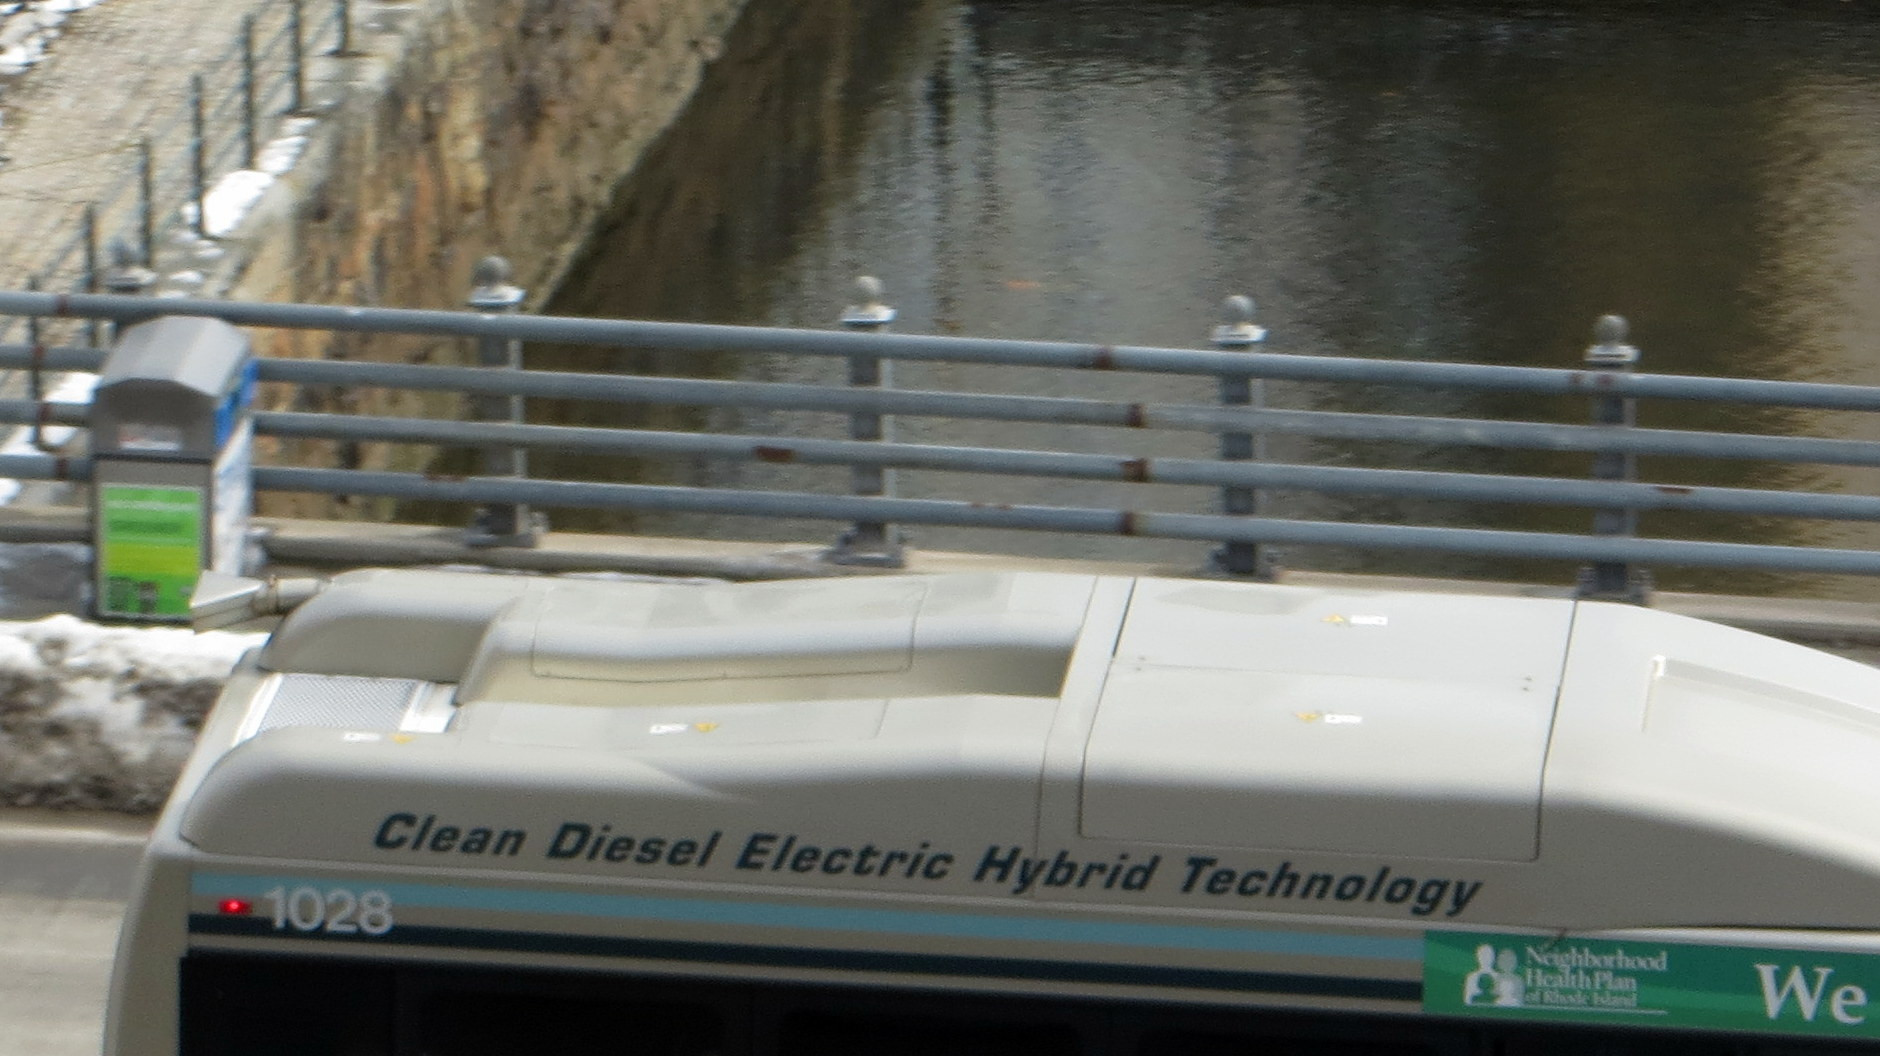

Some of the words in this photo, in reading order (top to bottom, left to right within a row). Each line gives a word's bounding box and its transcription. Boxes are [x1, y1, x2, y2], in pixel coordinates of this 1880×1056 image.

[374, 811, 528, 857] Clean
[546, 821, 724, 871] Diesel
[735, 831, 956, 881] Electric
[973, 844, 1162, 896] Hybrid
[1180, 856, 1485, 918] Technology
[262, 885, 394, 936] 1028
[1525, 967, 1592, 990] Health
[1593, 970, 1637, 992] Plan
[1526, 945, 1668, 971] Neighborhood
[1753, 963, 1869, 1025] We
